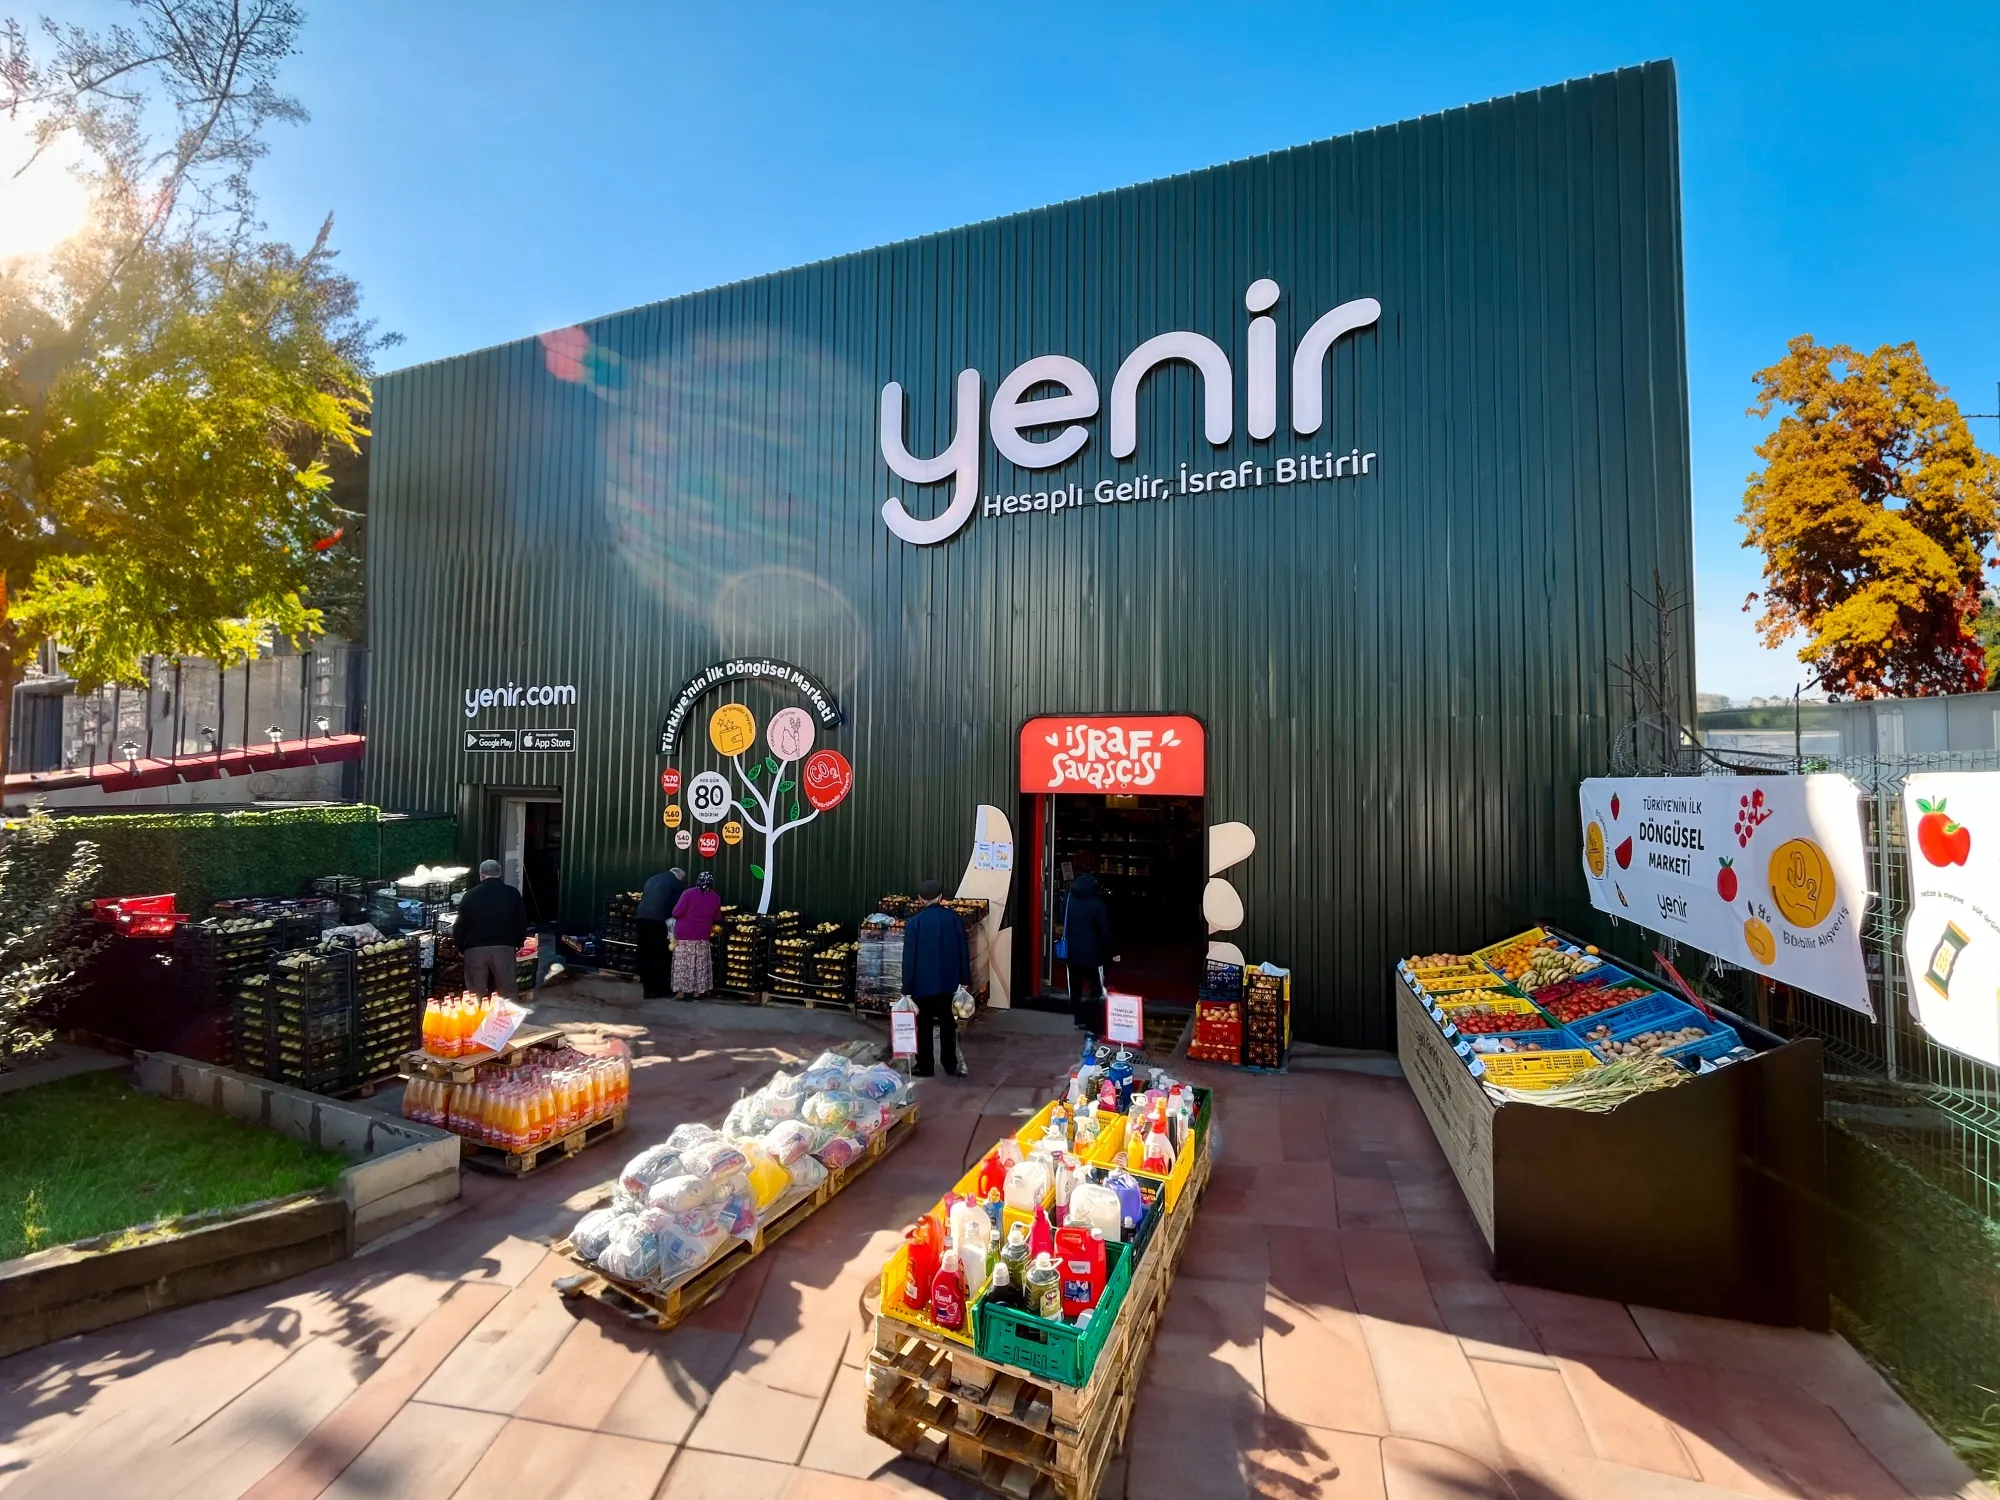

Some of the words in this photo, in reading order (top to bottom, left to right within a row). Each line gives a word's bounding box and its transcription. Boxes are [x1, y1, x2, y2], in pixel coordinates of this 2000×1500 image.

[881, 279, 1381, 545] yenir
[984, 484, 1083, 517] Hesaplı
[1094, 474, 1169, 506] Gelir,
[1181, 463, 1262, 495] İsrafı
[1276, 448, 1377, 484] Bitirir
[464, 681, 576, 718] yenir.com
[662, 677, 707, 752] Türkiye'nin
[705, 666, 725, 683] İlk
[726, 660, 791, 681] Döngüsel
[790, 671, 835, 722] Marketi
[478, 738, 500, 749] Google
[500, 738, 513, 749] Play
[535, 738, 550, 750] App
[550, 737, 571, 748] Store
[694, 784, 724, 810] 80
[1643, 795, 1687, 814] TÜRKİYE'NİN
[1688, 797, 1702, 815] İLK
[1640, 817, 1705, 851] DÖNGÜSEL
[1648, 852, 1691, 877] MARKETİ
[1657, 893, 1688, 919] yenir
